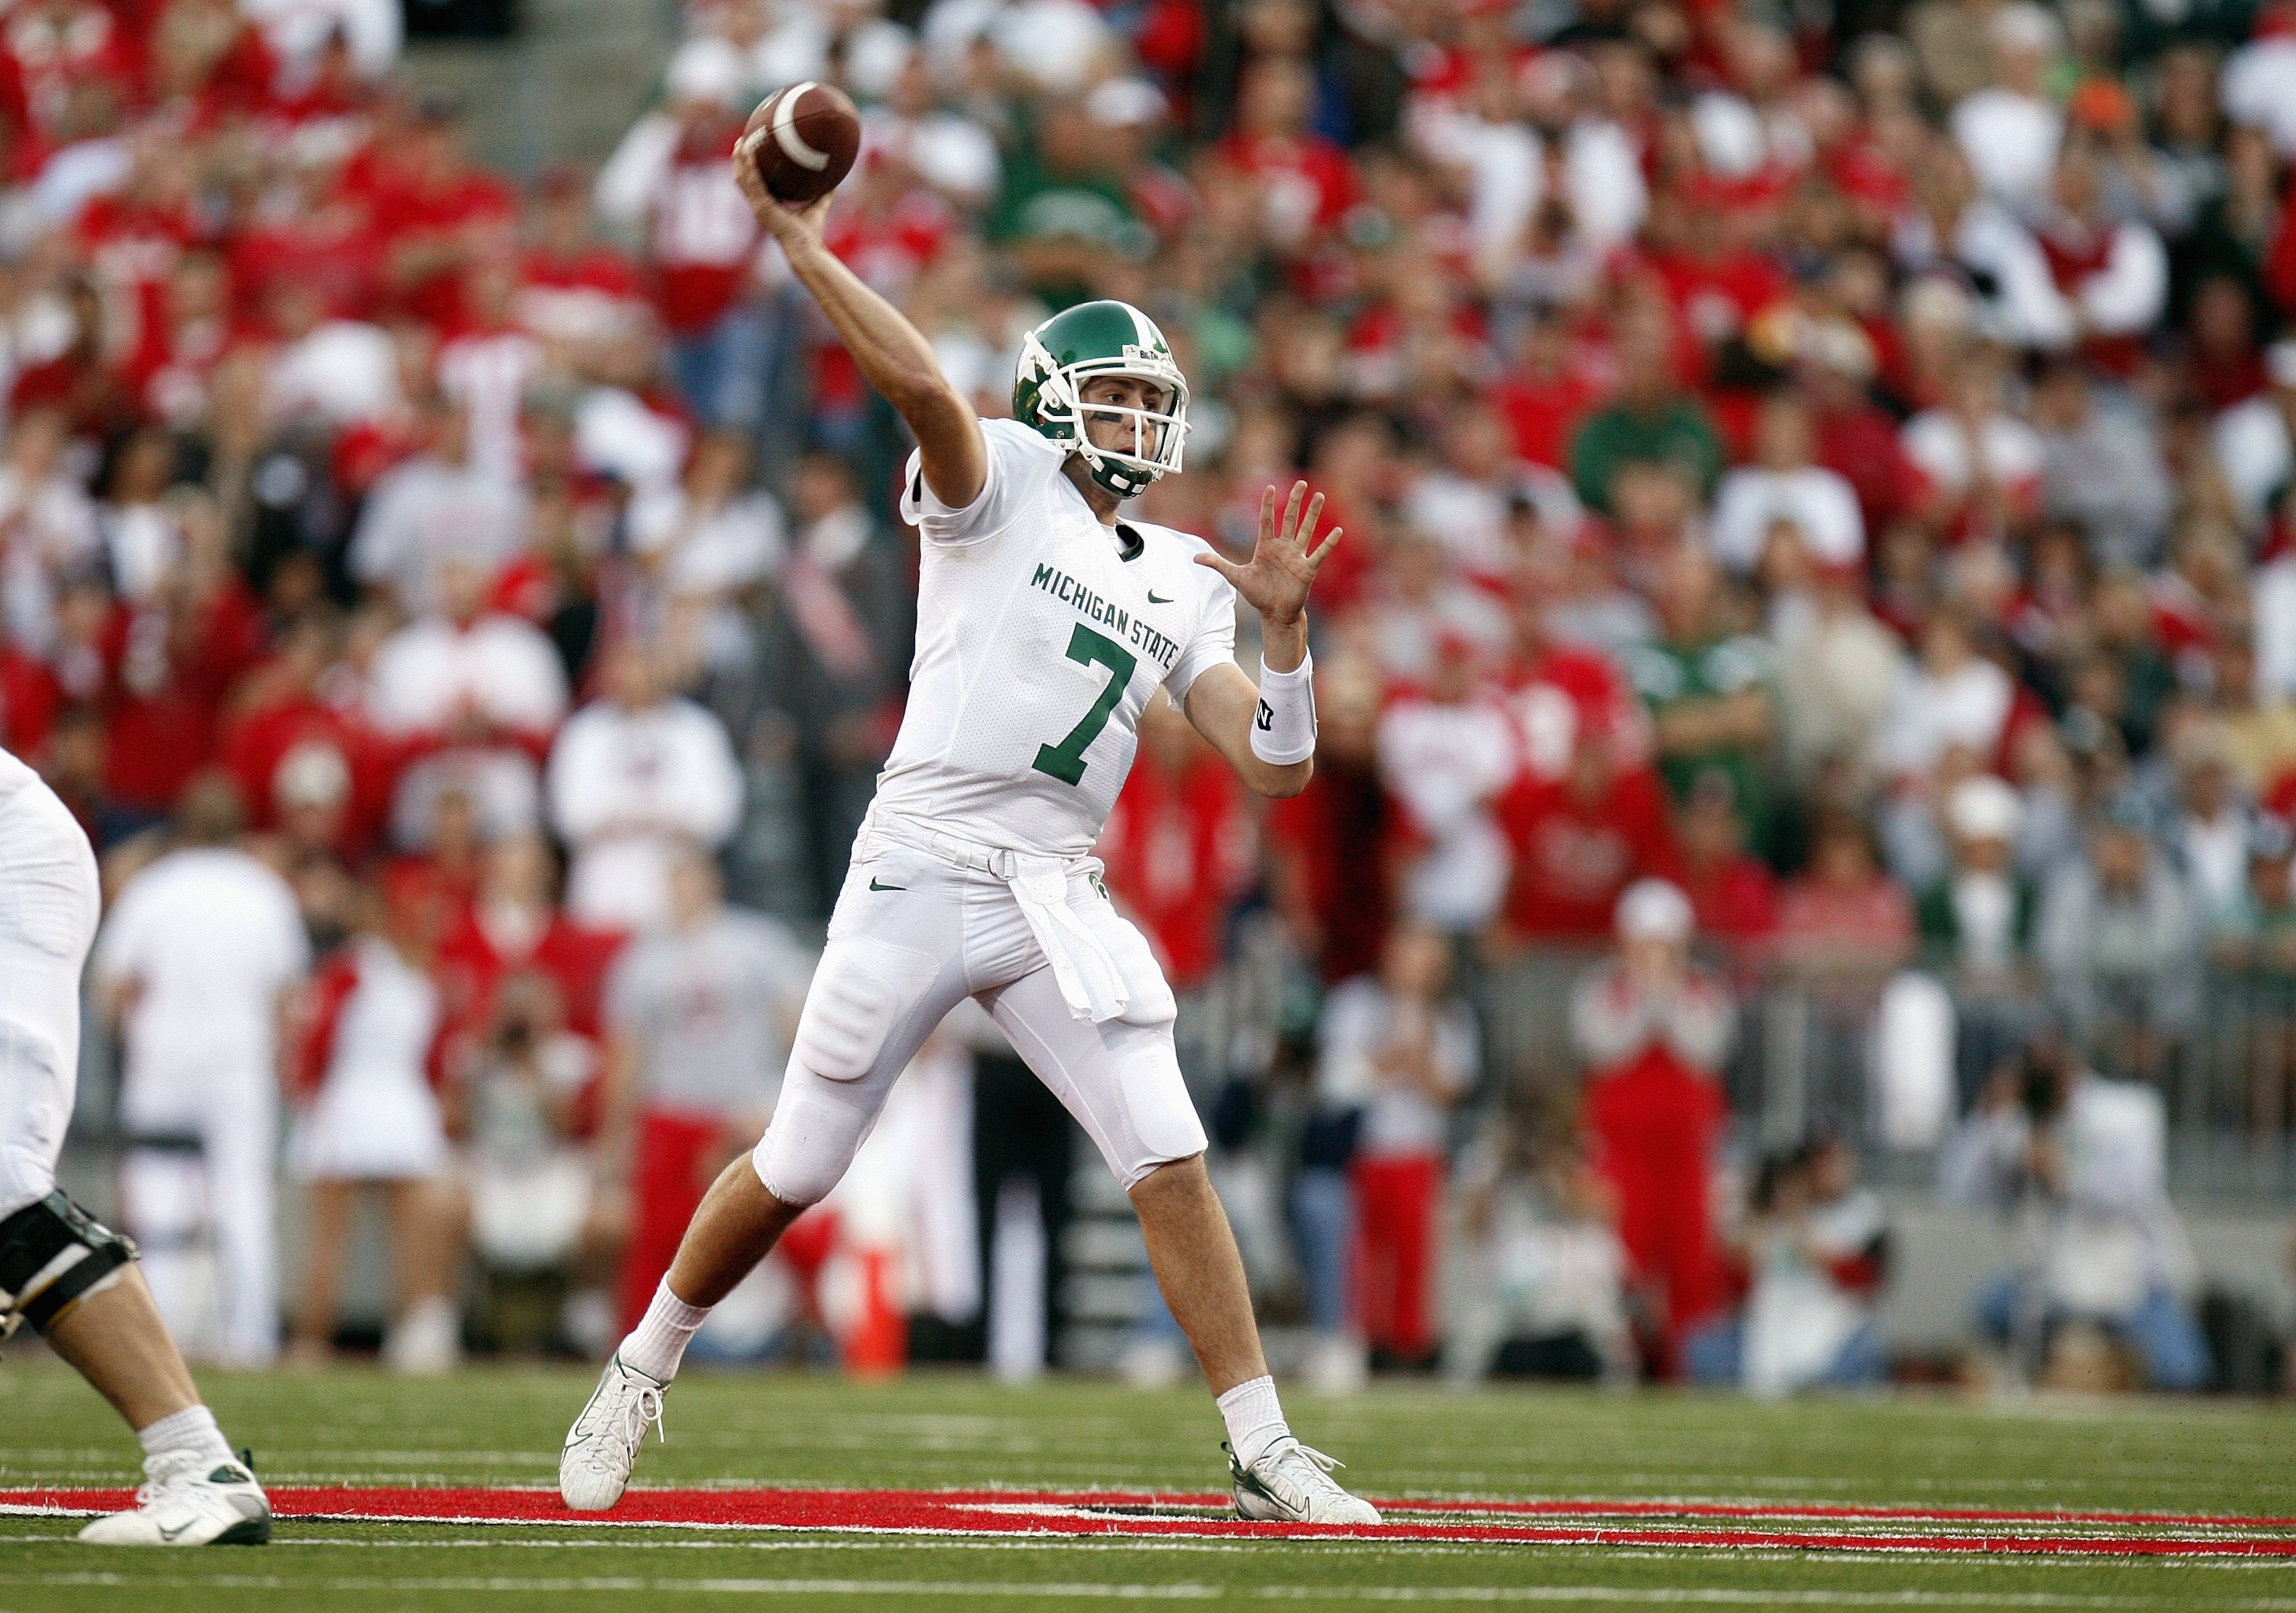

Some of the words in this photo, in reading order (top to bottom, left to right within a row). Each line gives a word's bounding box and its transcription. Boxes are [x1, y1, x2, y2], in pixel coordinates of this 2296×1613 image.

[1031, 562, 1129, 635] MICHIGAN
[1131, 619, 1180, 670] STATE
[1032, 622, 1138, 787] 7
